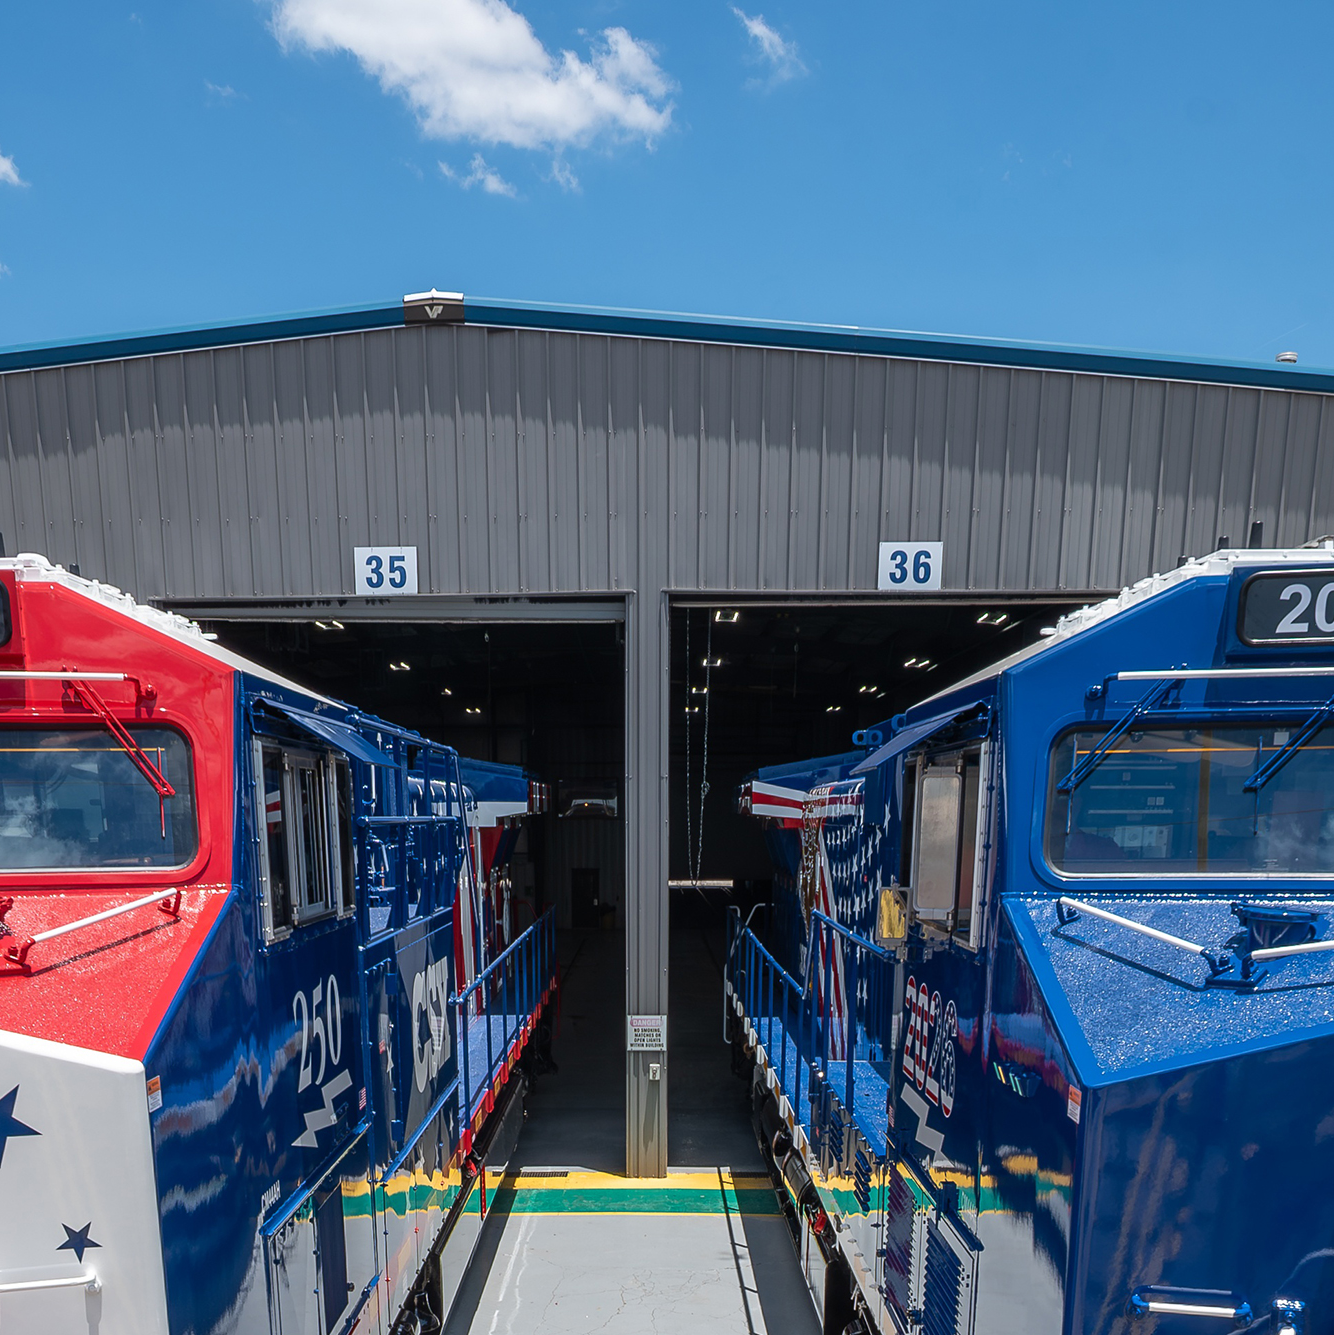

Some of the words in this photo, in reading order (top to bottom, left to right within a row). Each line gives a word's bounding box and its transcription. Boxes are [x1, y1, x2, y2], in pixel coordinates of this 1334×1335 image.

[365, 555, 407, 588] 35
[889, 550, 932, 584] 36
[292, 974, 342, 1094] 250
[412, 956, 451, 1094] CSX
[632, 1019, 662, 1027] DANGER
[902, 975, 958, 1119] 2026
